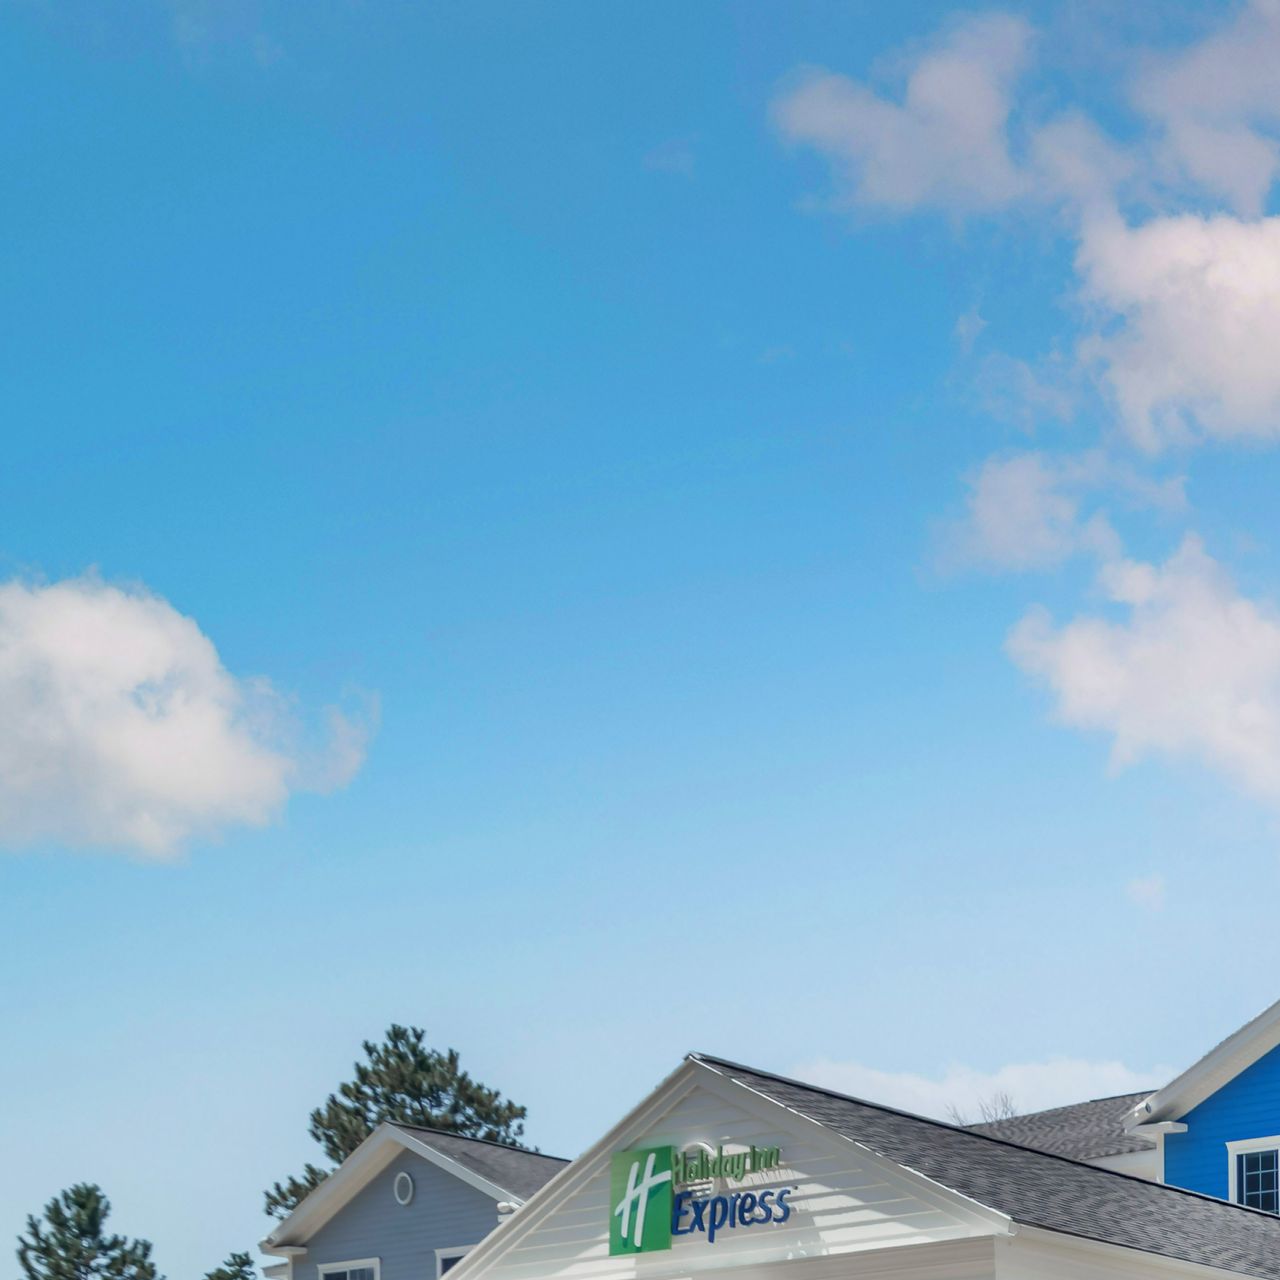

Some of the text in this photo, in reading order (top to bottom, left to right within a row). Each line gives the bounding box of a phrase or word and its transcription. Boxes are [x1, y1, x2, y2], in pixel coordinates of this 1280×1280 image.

[671, 1144, 781, 1186] Holiday Inn
[671, 1188, 792, 1243] Express
